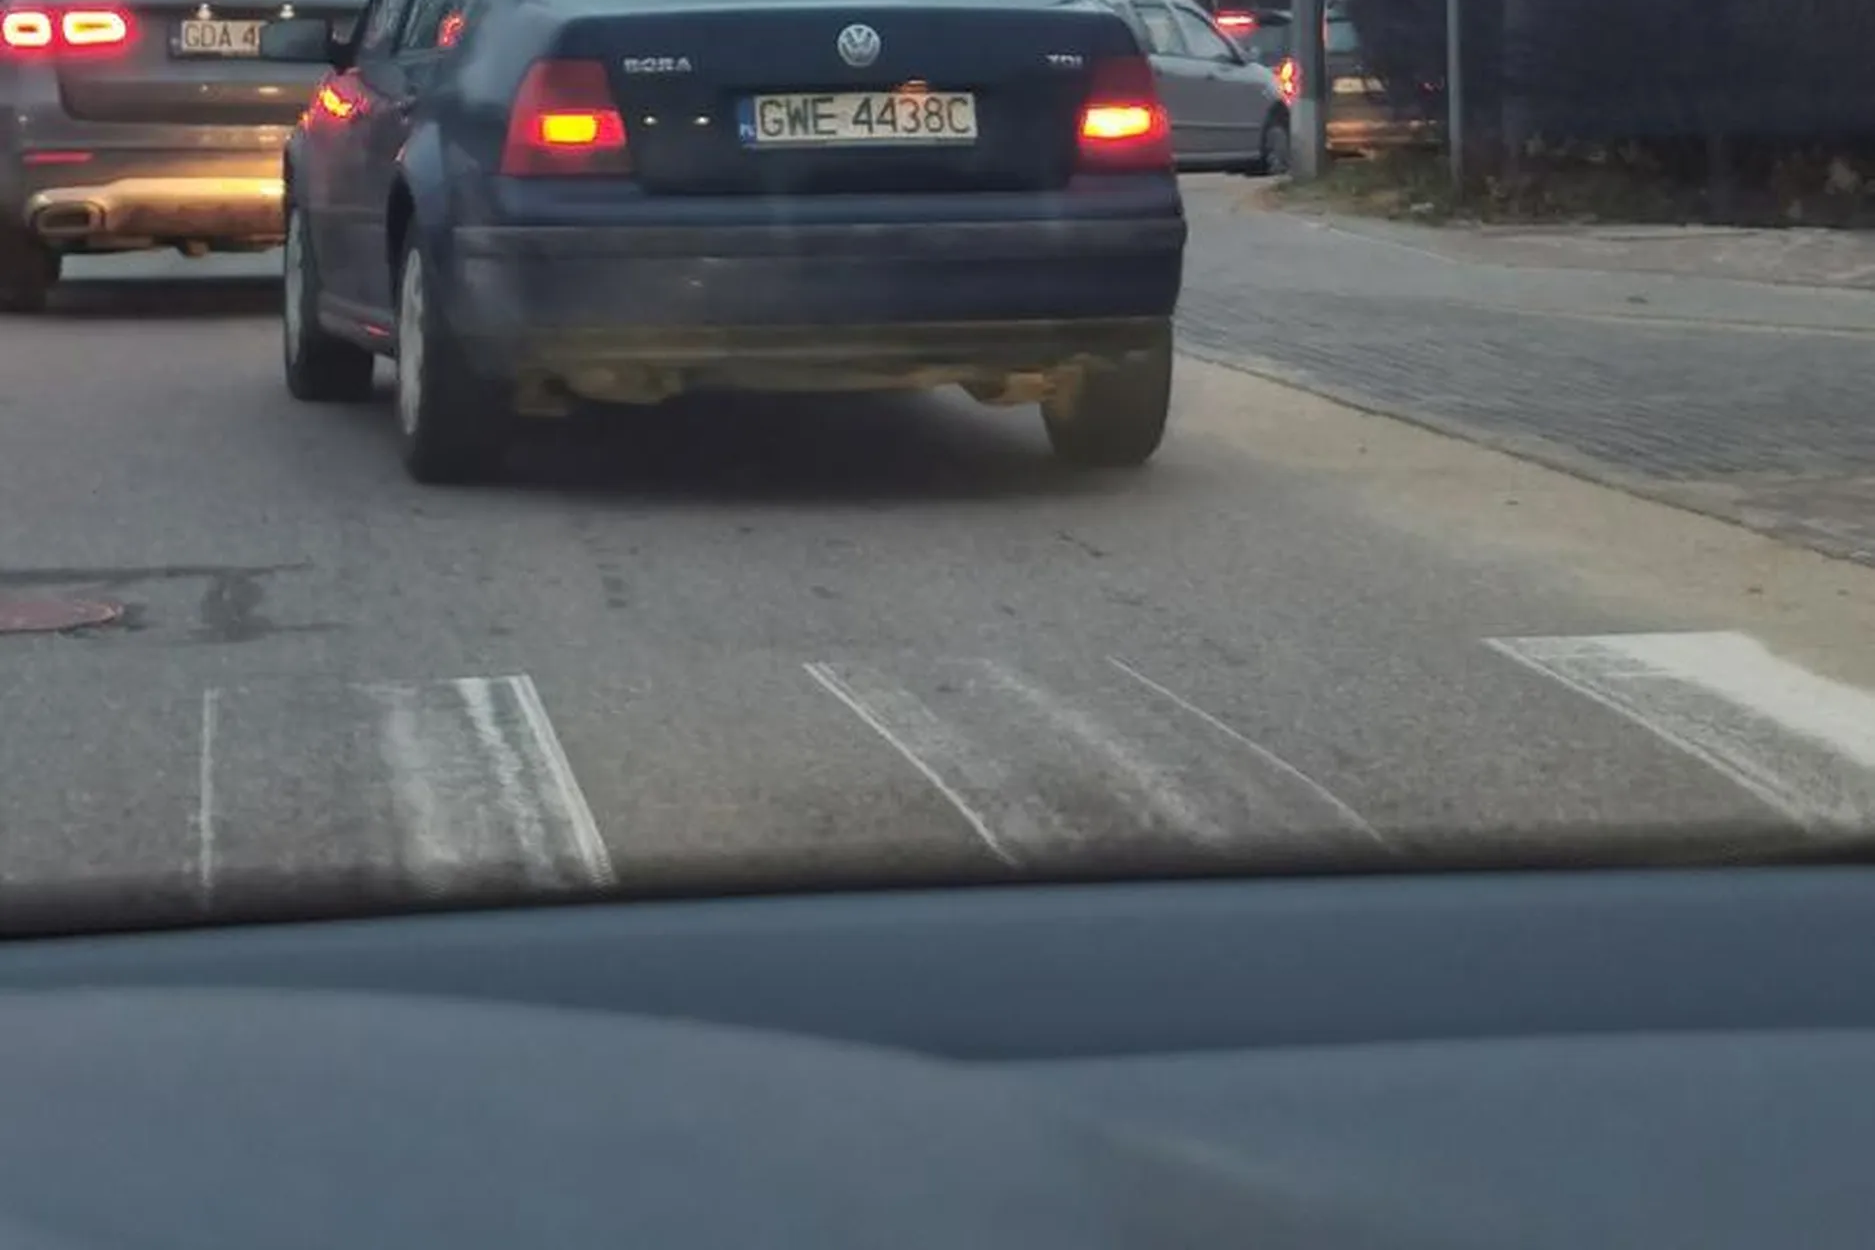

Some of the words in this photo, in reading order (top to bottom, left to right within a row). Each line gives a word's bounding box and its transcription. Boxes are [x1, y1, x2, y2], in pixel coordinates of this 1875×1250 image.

[185, 23, 232, 48] GDA
[623, 57, 692, 73] BORA
[759, 97, 837, 137] GWE
[852, 96, 971, 135] 4438C
